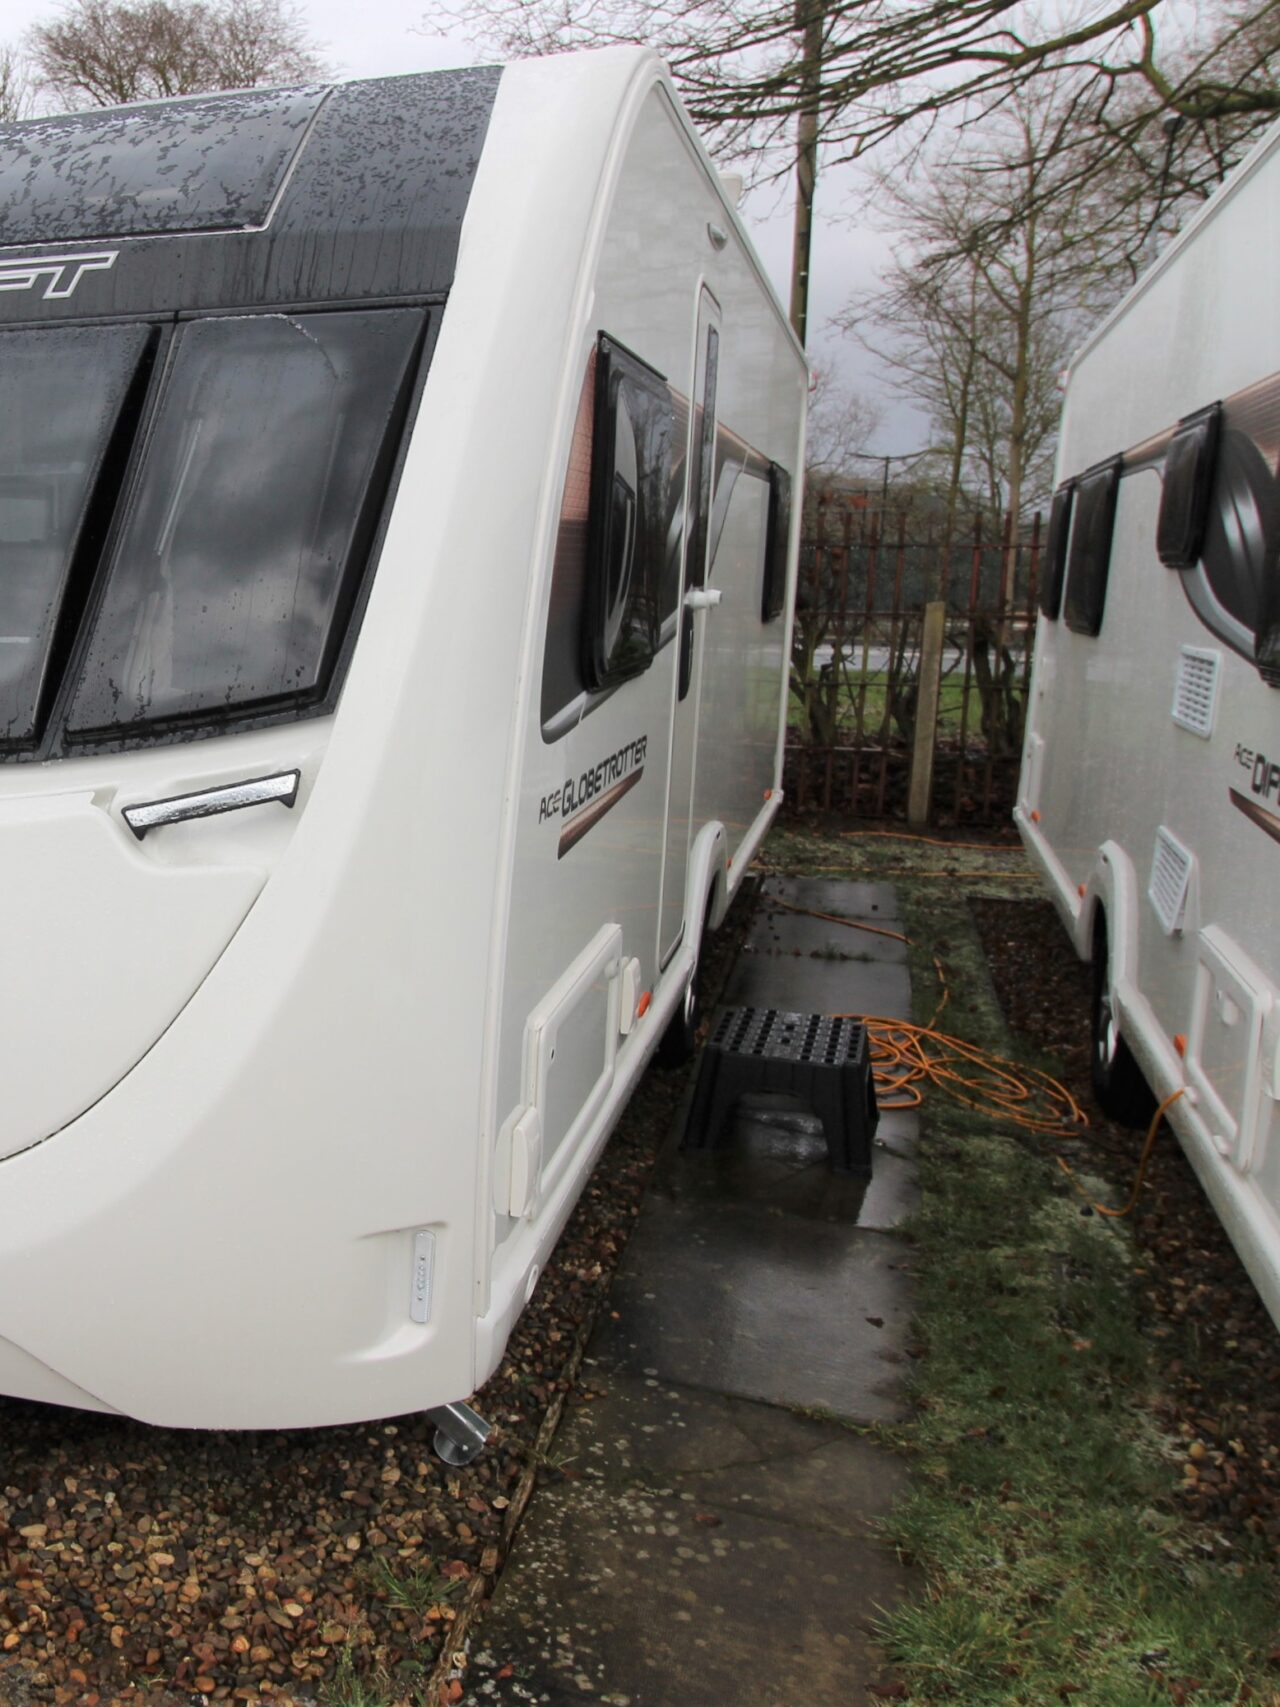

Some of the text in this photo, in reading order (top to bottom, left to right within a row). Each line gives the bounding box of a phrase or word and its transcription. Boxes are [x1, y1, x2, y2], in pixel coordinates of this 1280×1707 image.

[539, 734, 648, 825] ACE GLOBETROTTER
[1251, 752, 1280, 807] DIP
